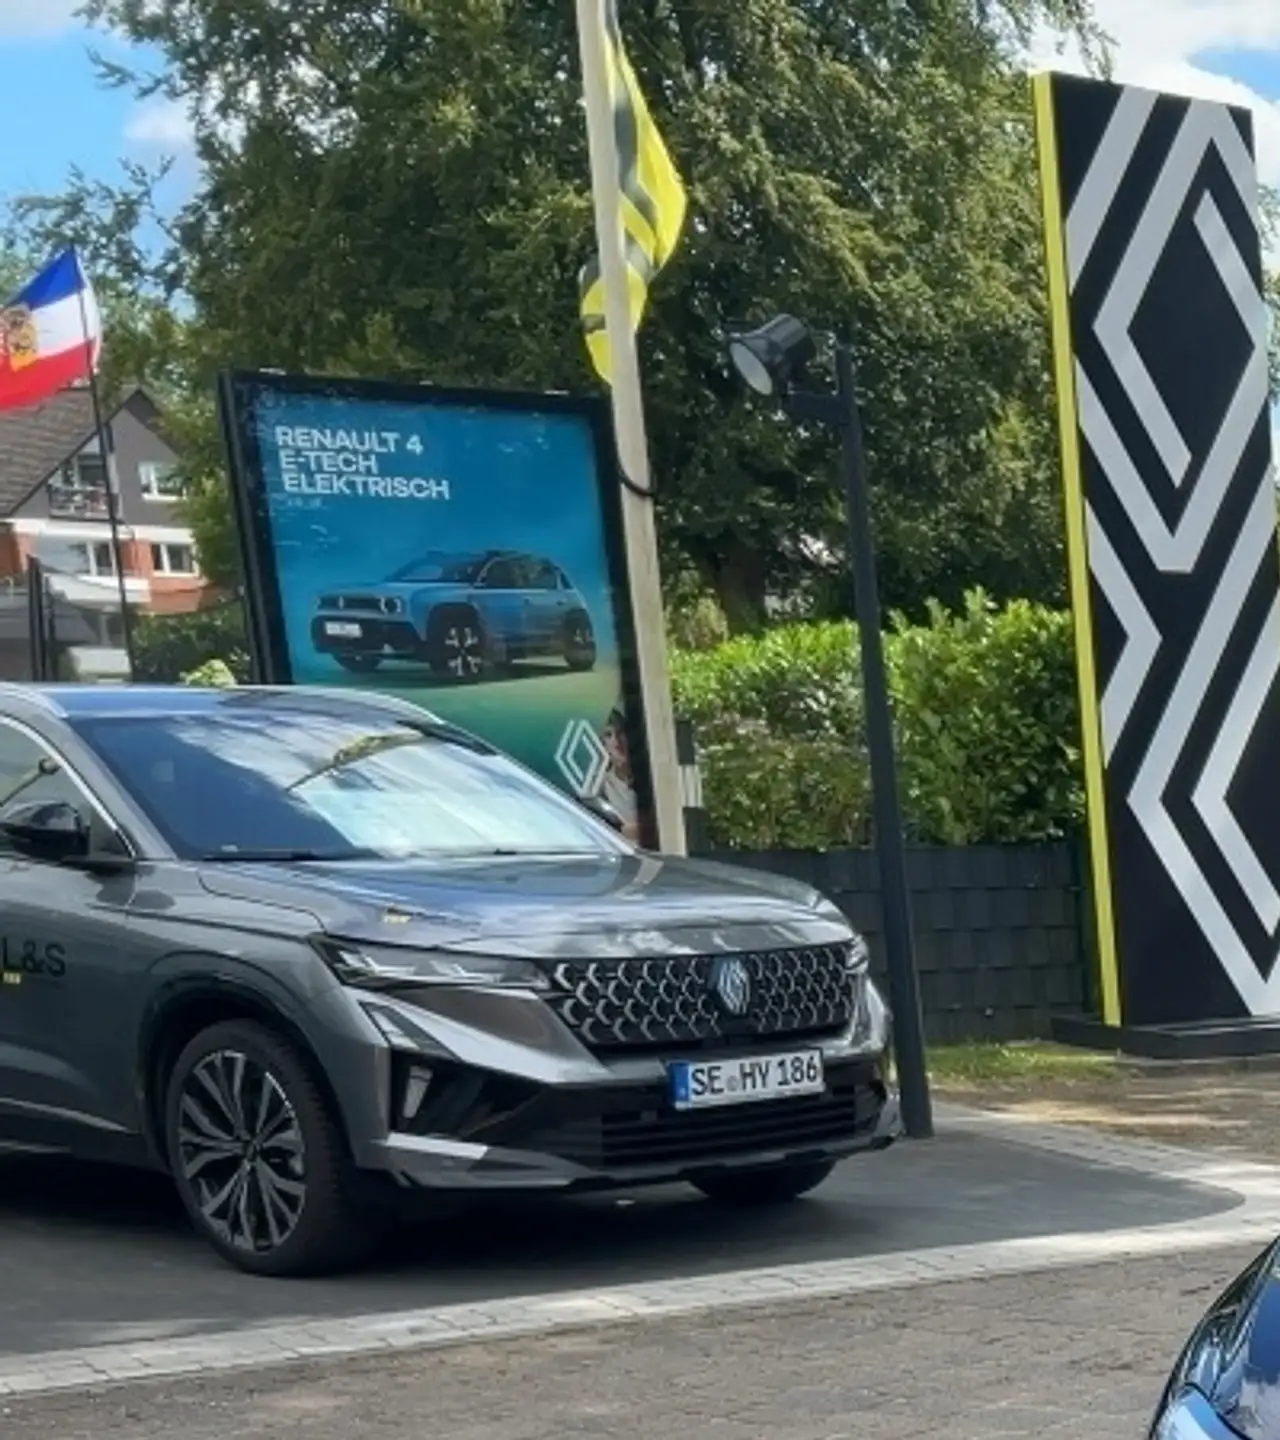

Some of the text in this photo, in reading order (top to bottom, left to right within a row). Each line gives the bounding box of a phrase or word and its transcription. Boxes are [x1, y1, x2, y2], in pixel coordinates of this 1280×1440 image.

[275, 426, 424, 455] RENAULT 4
[279, 449, 378, 474] E-TECH
[282, 473, 451, 500] ELEKTRISCH
[3, 938, 66, 977] L&S
[692, 1056, 817, 1095] SE HY 186
